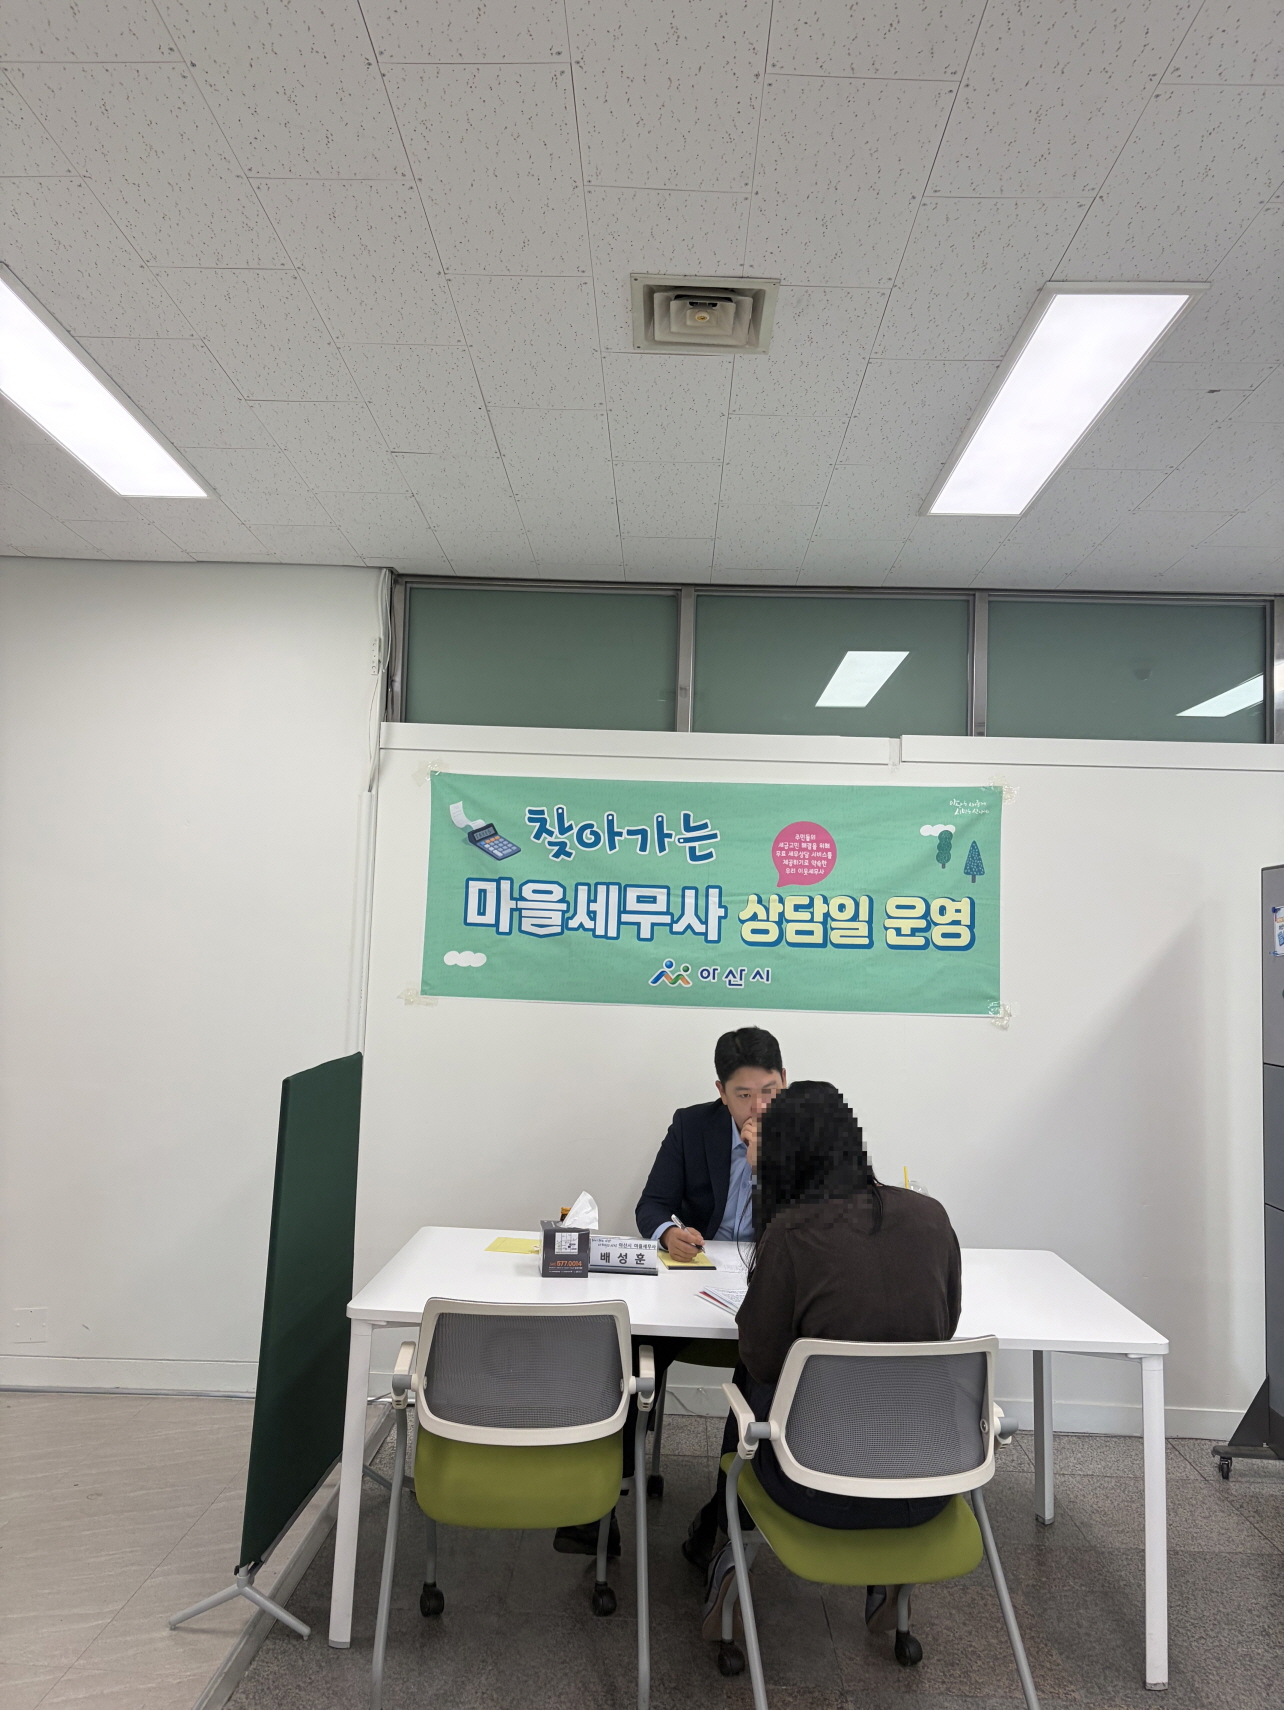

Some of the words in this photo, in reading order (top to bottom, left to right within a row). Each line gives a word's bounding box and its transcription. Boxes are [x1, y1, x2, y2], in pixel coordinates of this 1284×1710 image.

[526, 805, 720, 864] 찾아가는
[795, 834, 816, 842] 주민들의
[778, 842, 799, 850] 세금고민
[788, 851, 809, 859] 세무상담
[811, 851, 832, 859] 서비스를
[783, 859, 809, 867] 제공하기로
[464, 877, 728, 943] 마을세무사
[738, 893, 874, 949] 상담일
[884, 896, 975, 951] 운영
[698, 966, 772, 988] 아산시
